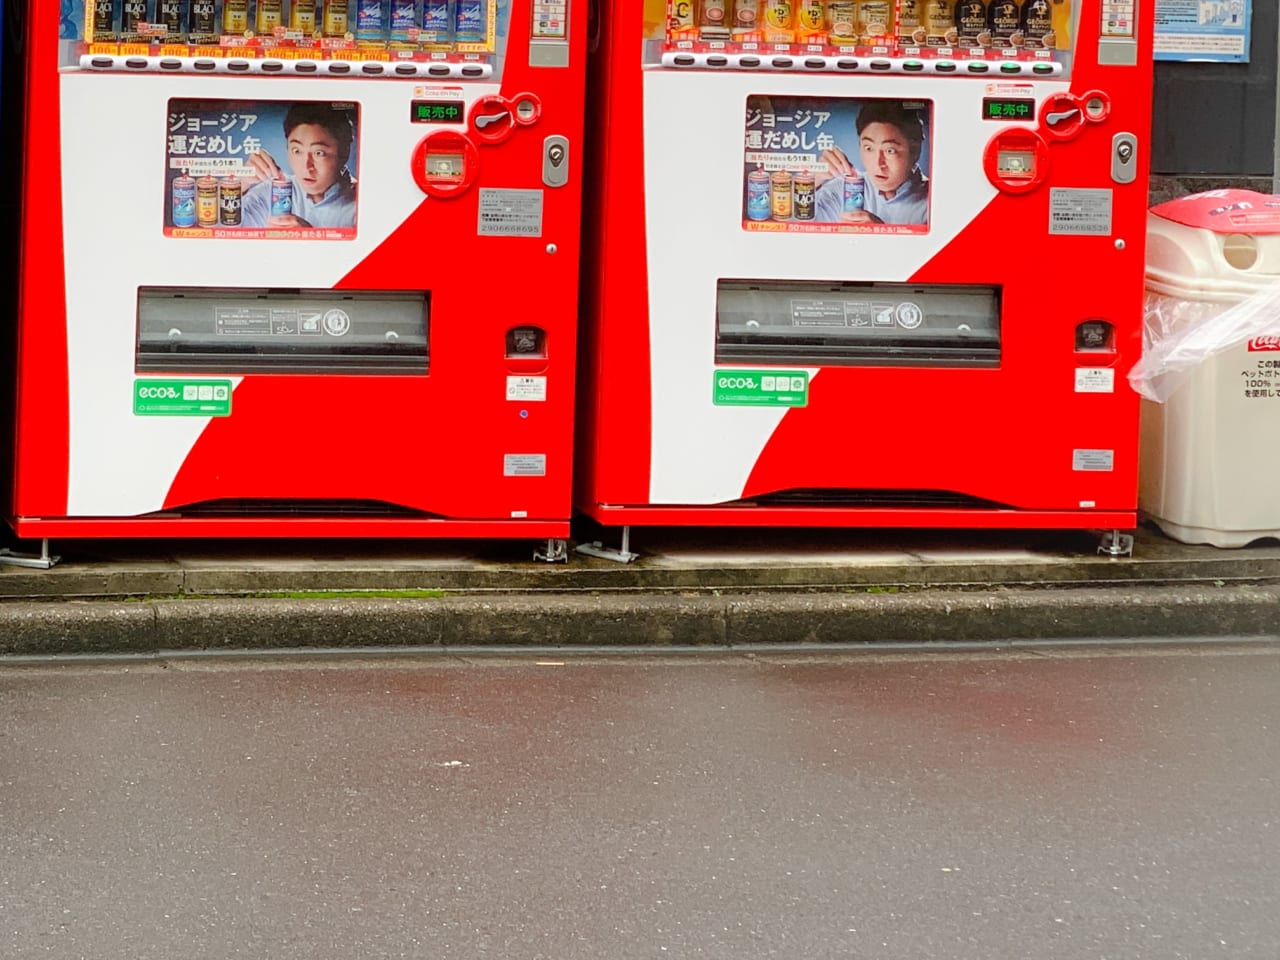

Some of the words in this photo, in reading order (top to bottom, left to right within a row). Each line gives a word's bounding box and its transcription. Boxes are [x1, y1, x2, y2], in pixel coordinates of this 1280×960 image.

[417, 106, 458, 119] 販売中
[745, 109, 831, 128] ジョージア
[989, 103, 1029, 116] 販売中
[168, 113, 258, 132] ジョージア
[168, 135, 261, 155] 運だめし缶
[745, 130, 835, 150] 運だめし缶
[1245, 380, 1272, 388] 100%
